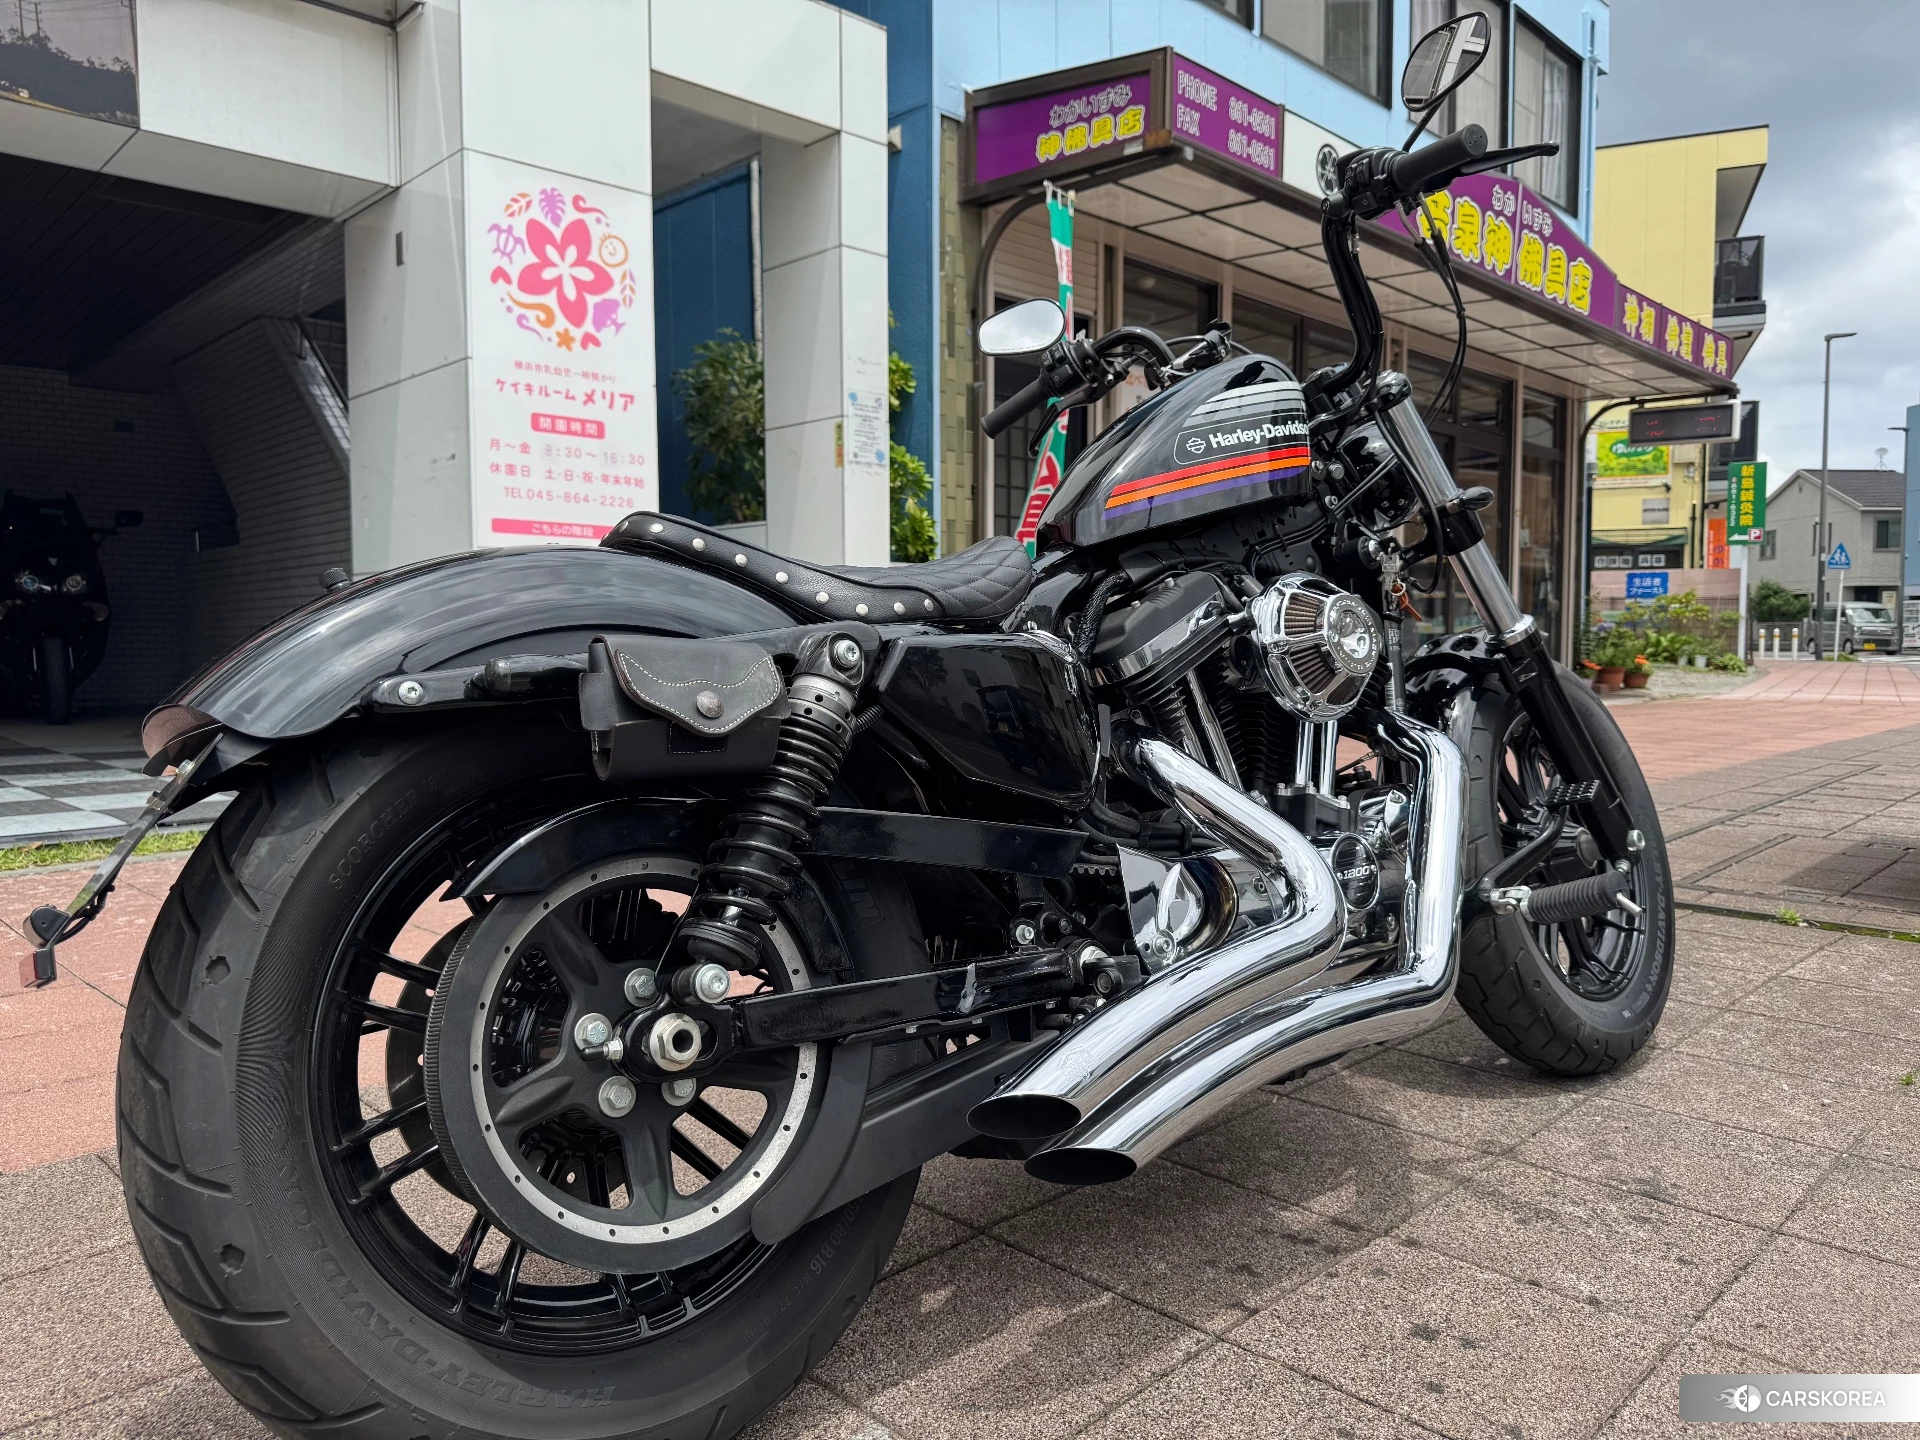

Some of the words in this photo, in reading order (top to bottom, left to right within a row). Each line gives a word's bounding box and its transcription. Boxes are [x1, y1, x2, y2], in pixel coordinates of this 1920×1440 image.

[1177, 69, 1218, 111] PHONE
[1049, 83, 1132, 129] わかいずみ
[1176, 104, 1201, 137] FAX
[496, 378, 577, 401] ケイキルーム
[582, 389, 635, 412] メリア
[489, 462, 531, 478] 休園日
[531, 522, 594, 537] こちらの階段
[1632, 577, 1662, 587] 生活者
[1343, 865, 1370, 880] 1200
